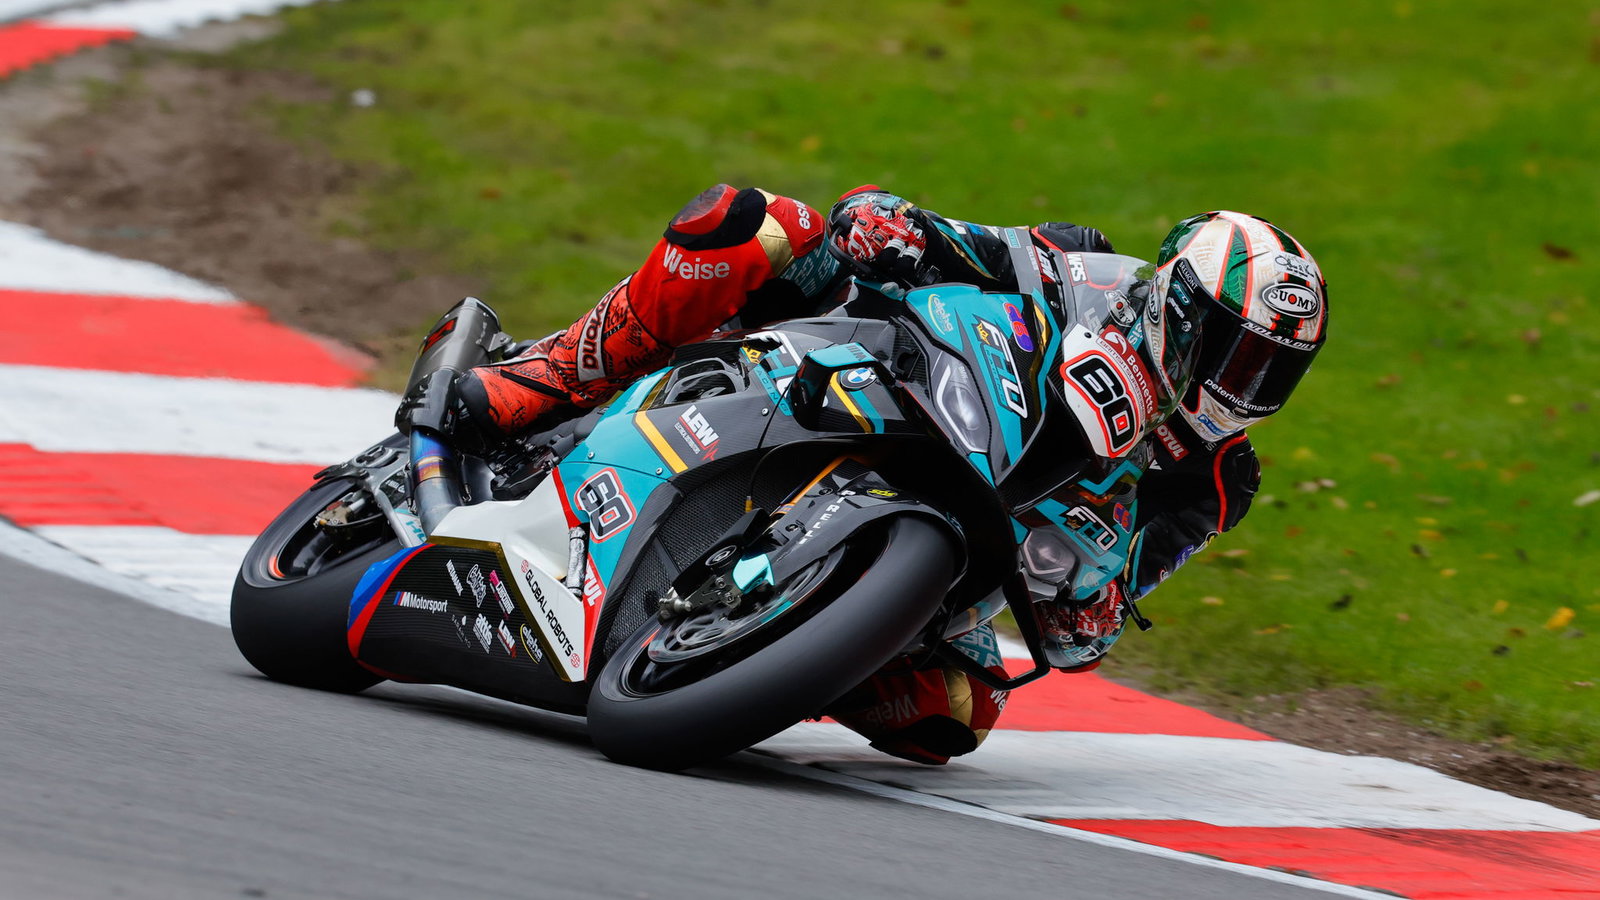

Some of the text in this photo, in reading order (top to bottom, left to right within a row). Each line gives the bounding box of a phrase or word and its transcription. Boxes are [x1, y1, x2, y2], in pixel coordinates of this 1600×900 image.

[663, 242, 730, 280] Weise
[1067, 253, 1087, 282] WRS
[1179, 261, 1199, 290] BREMONT
[933, 296, 954, 333] alpha
[1269, 287, 1317, 313] SUOMY
[582, 288, 613, 370] aytona
[1241, 320, 1317, 350] NOLAN OILS
[979, 319, 1028, 419] FHO
[1126, 354, 1154, 414] Bennetts
[755, 368, 790, 413] ACING
[1066, 354, 1137, 453] 60
[1204, 377, 1280, 412] peterhickman.net
[680, 404, 720, 447] LEW
[1157, 424, 1185, 458] OTUL
[576, 470, 633, 540] 60
[799, 489, 857, 545] PIRELLI
[1066, 505, 1119, 551] FHO
[584, 559, 603, 607] TUL
[410, 594, 448, 614] Motorsport
[525, 568, 574, 657] GLOBAL ROBOTS
[475, 613, 493, 646] attis
[499, 619, 516, 649] LEW
[522, 625, 543, 662] alpha
